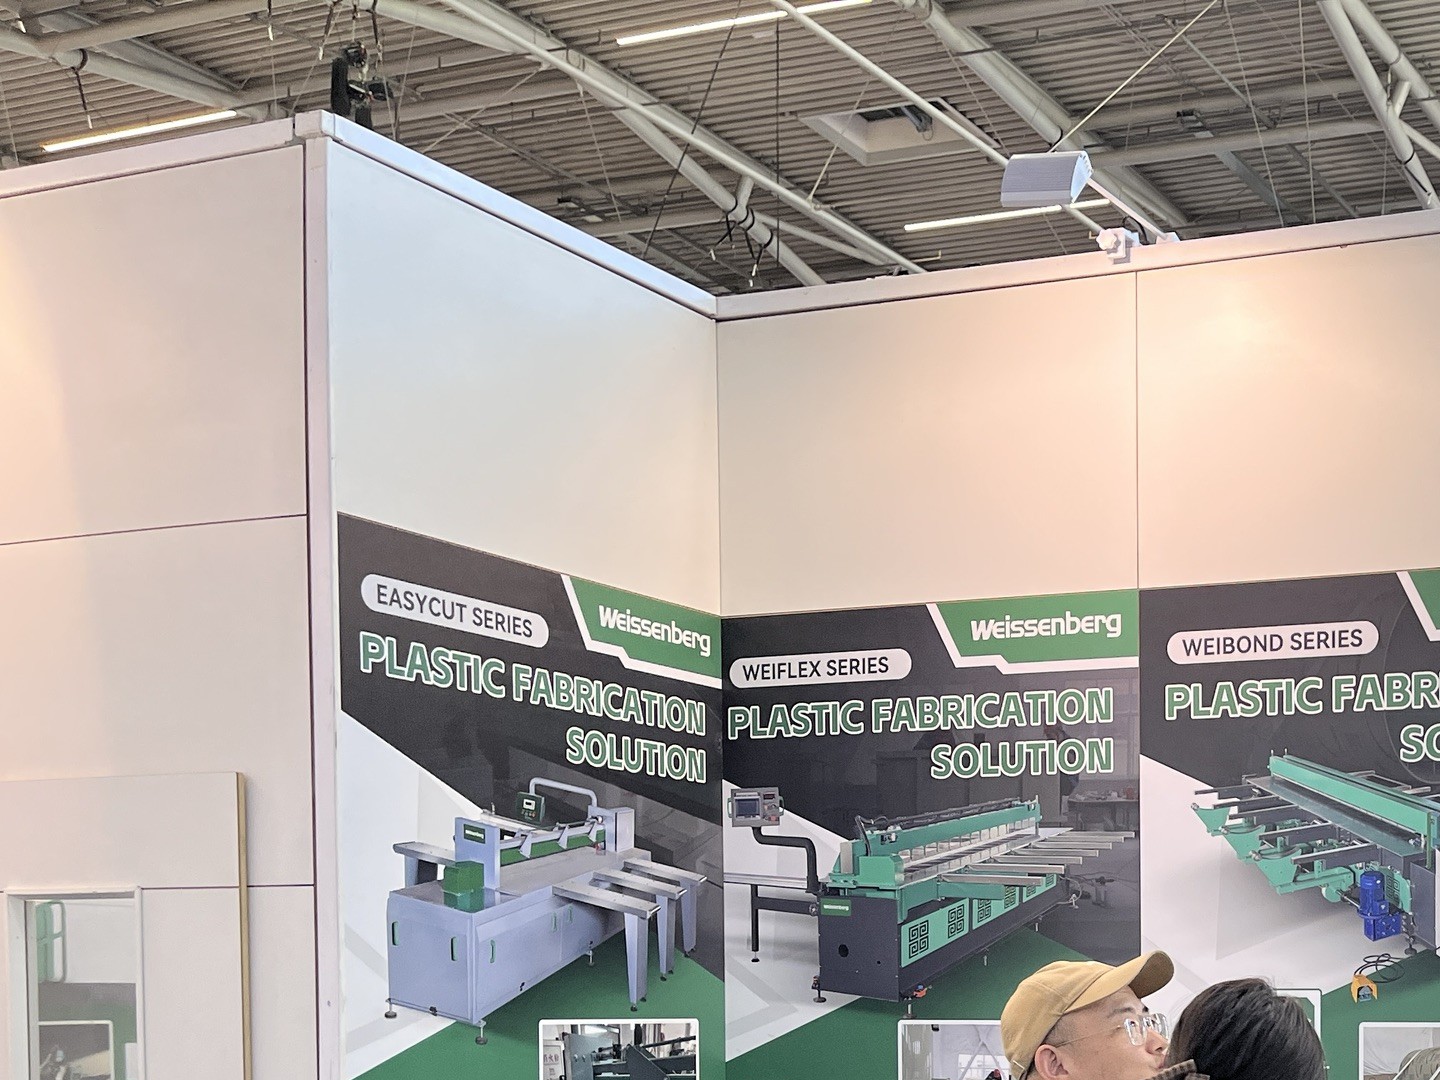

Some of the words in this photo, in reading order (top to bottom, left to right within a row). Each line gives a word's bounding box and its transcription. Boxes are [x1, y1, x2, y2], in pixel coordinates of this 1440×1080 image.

[376, 583, 467, 625] EASYCUT
[472, 606, 533, 638] SERIES
[598, 605, 711, 658] Weissenberg
[970, 611, 1122, 642] Weissenberg
[1183, 633, 1284, 656] WEIBOND
[1289, 629, 1363, 651] SERIES
[359, 632, 505, 700] PLASTIC
[511, 664, 707, 736] FABRICATION
[742, 658, 822, 681] WEIFLEX
[826, 656, 889, 678] SERIES
[728, 700, 864, 740] PLASTIC
[871, 687, 1114, 733] FABRICATION
[1165, 676, 1324, 721] PLASTIC
[565, 729, 707, 783] SOLUTION
[930, 737, 1114, 780] SOLUTION
